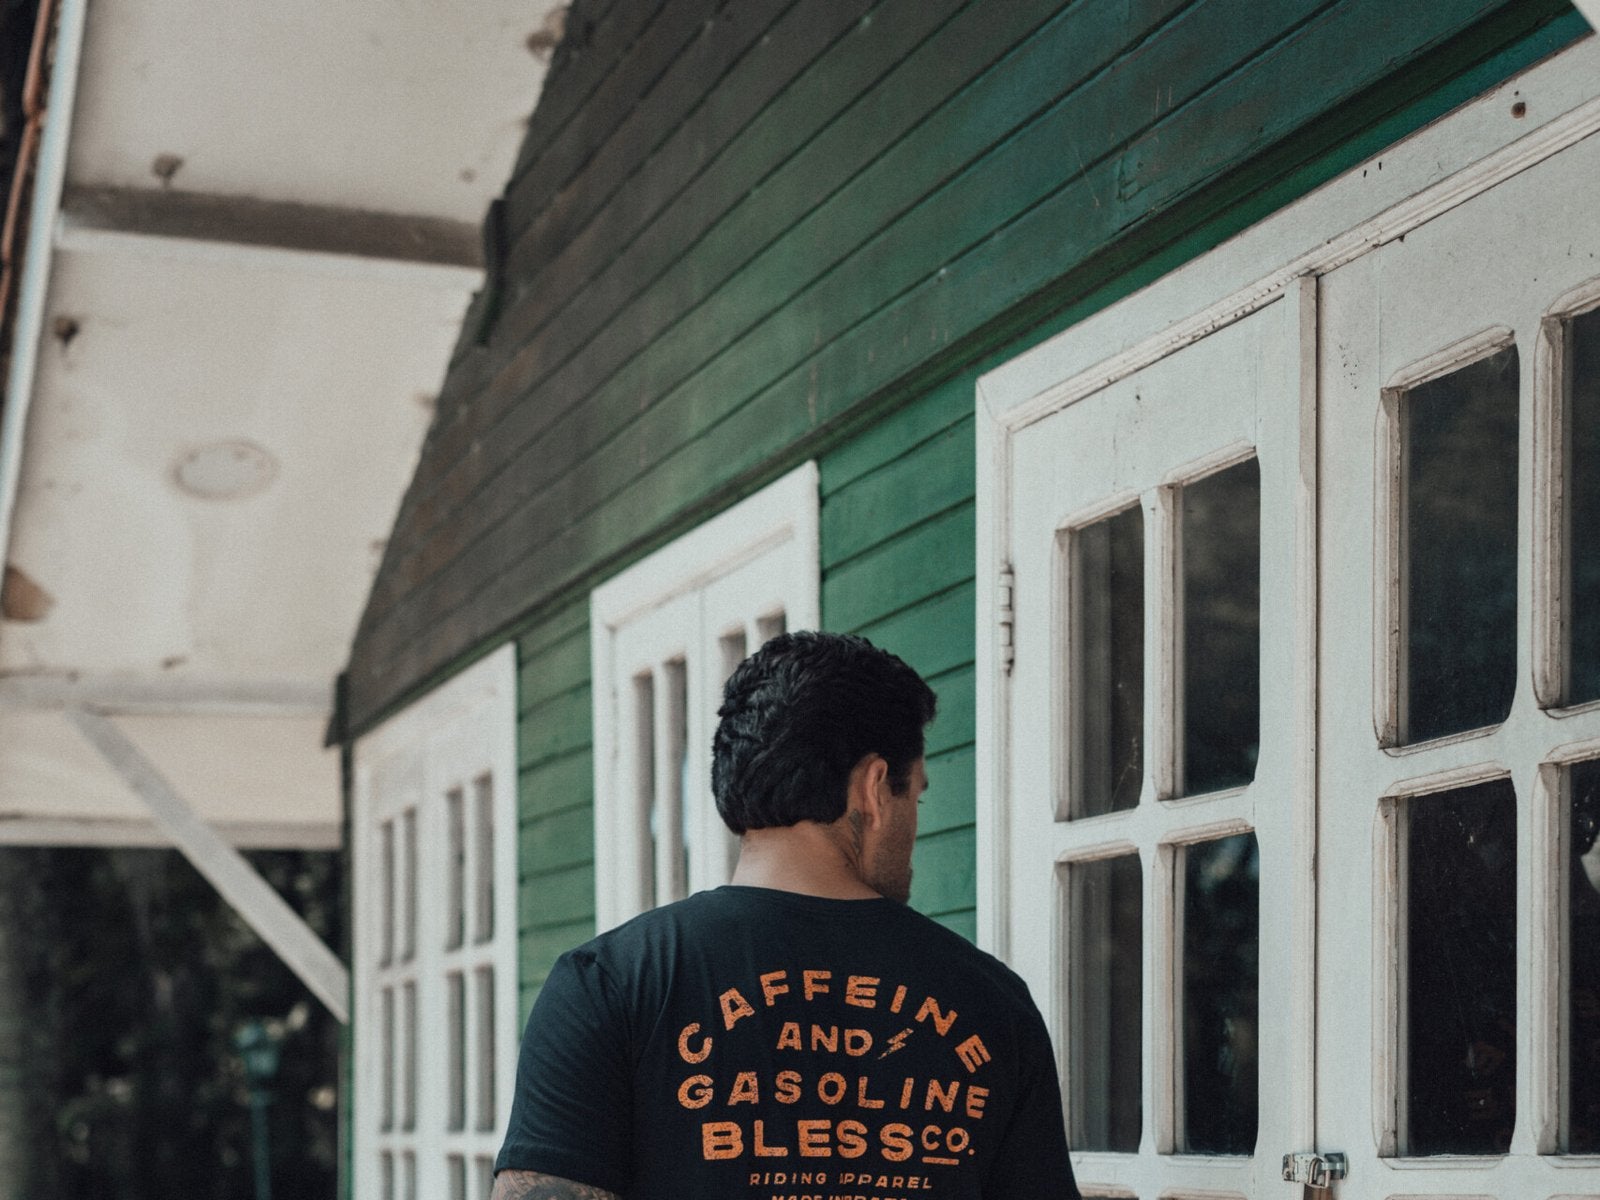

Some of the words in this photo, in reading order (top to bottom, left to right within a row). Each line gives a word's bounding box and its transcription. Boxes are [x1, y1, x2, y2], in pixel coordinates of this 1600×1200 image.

[677, 969, 992, 1073] CAFFEINE
[776, 1021, 873, 1057] AND
[677, 1070, 990, 1119] GASOLINE
[701, 1119, 914, 1163] BLESS
[921, 1124, 975, 1156] CO.
[749, 1172, 827, 1185] RIDING
